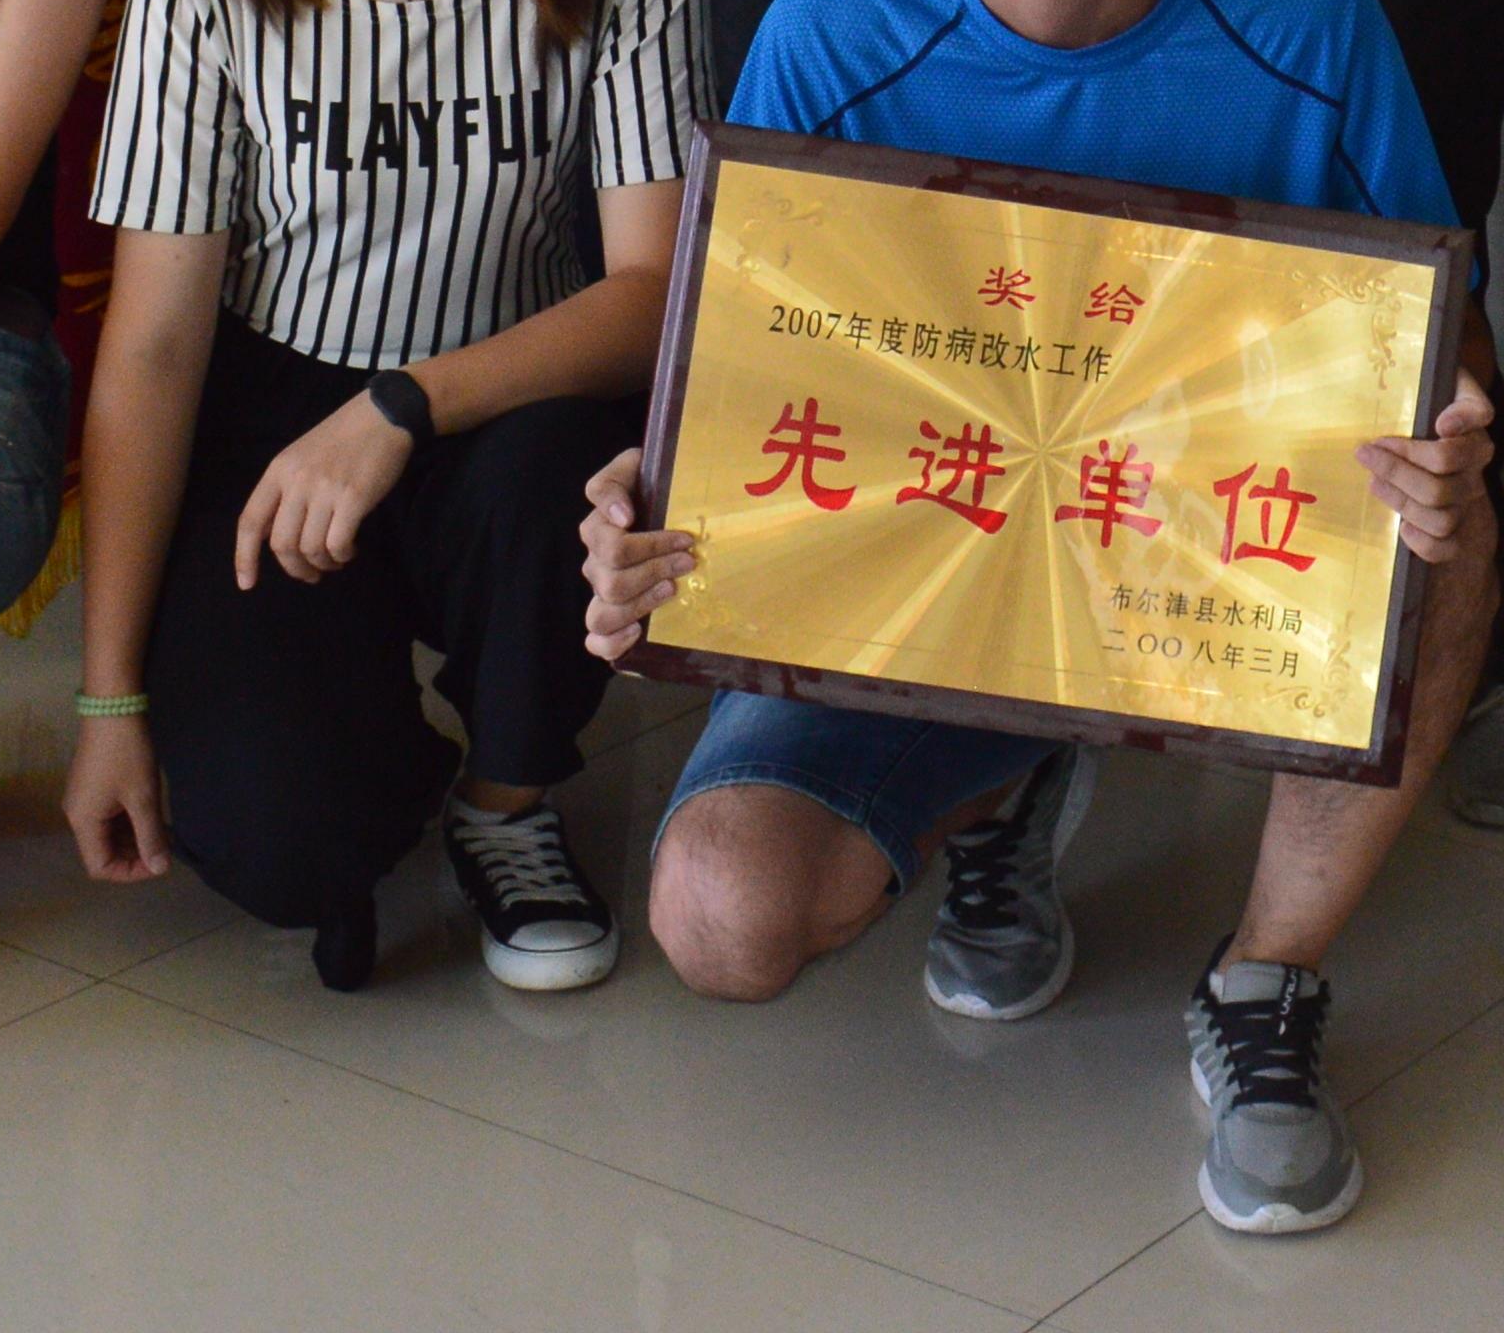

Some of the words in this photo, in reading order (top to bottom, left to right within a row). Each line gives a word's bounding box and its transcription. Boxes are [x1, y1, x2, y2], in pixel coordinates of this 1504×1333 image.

[285, 89, 553, 171] PLAYFUL
[977, 267, 1146, 326] 奖给
[768, 304, 1114, 383] 2007年度防病改水工作
[744, 398, 1319, 572] 先进单位
[1109, 581, 1304, 636] 布尔津县水利局
